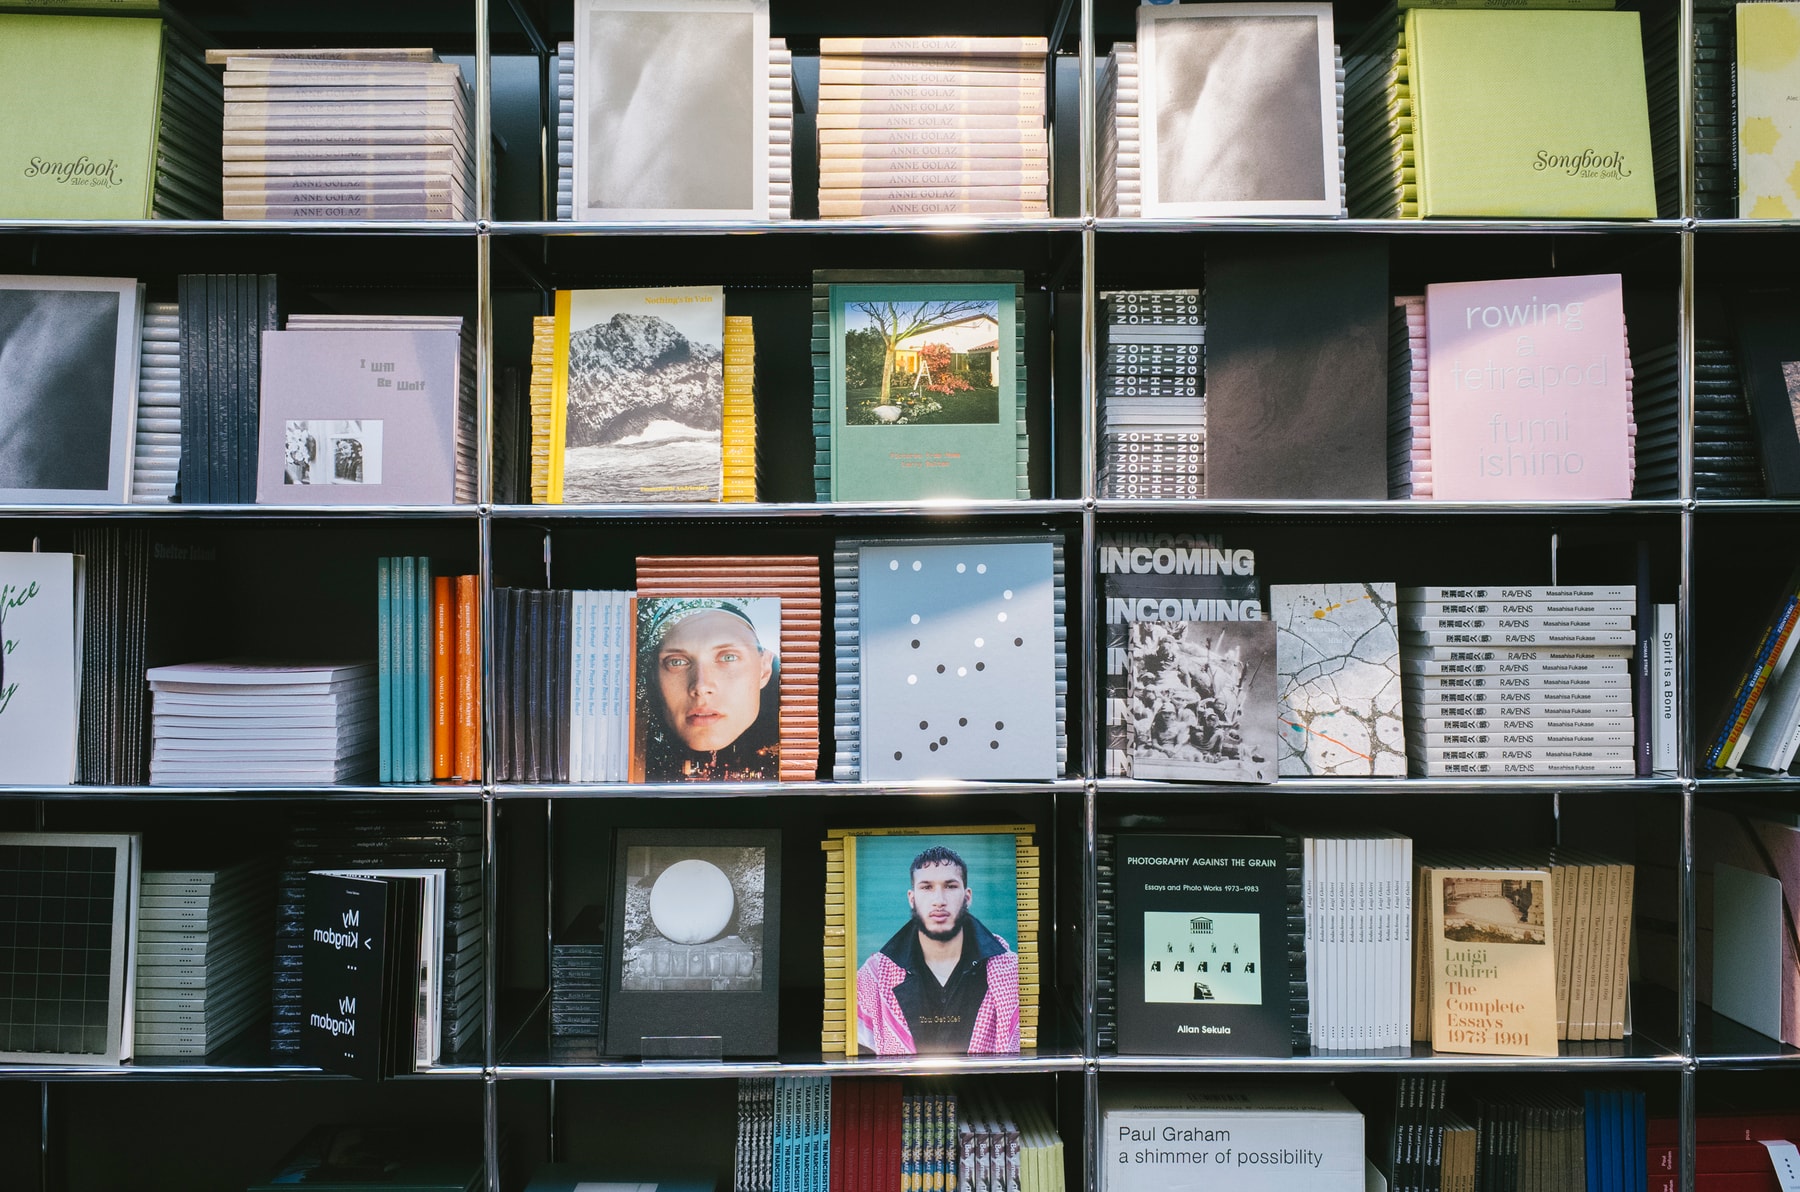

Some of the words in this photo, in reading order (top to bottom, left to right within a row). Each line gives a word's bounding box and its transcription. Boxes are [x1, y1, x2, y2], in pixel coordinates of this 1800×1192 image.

[890, 41, 919, 49] ANNE
[922, 41, 957, 49] GOLAZ
[1533, 149, 1631, 177] Songbook
[24, 156, 122, 186] Songbook
[1600, 170, 1621, 180] Soth
[90, 177, 112, 188] Soth
[1116, 295, 1196, 304] NOTHING
[1117, 304, 1197, 314] NOTHING
[1466, 296, 1584, 331] rowing
[1117, 315, 1198, 325] NOTHING
[1118, 345, 1198, 354] NOTHING
[1516, 336, 1534, 356] a
[1116, 355, 1198, 364] NOTHING
[1116, 365, 1198, 375] NOTHING
[1115, 376, 1196, 386] NOTHING
[1452, 356, 1608, 396] tetrapod
[377, 378, 391, 387] Be
[1115, 386, 1196, 396] NOTHING
[1489, 410, 1569, 443] fumi
[1118, 433, 1199, 442] NOTHING
[1118, 443, 1198, 453] NOTHING
[1480, 443, 1584, 478] ishino
[1117, 464, 1197, 474] NOTHING
[1117, 474, 1197, 484] NOTHING
[1116, 485, 1197, 494] NOTHING
[1101, 547, 1254, 576] INCOMING
[1107, 598, 1262, 624] INCOMING
[1663, 632, 1672, 665] Spirit
[1664, 666, 1672, 676] is
[1664, 691, 1673, 719] Bone
[1504, 721, 1533, 729] RAVENS
[1128, 857, 1189, 866] PHOTOGRAPHY
[1193, 858, 1228, 867] AGAINST
[1232, 858, 1246, 867] THE
[1248, 859, 1276, 868] GRAIN
[1145, 884, 1165, 892] Essays
[1446, 948, 1486, 966] Luigi
[1445, 964, 1497, 978] Ghirri
[1445, 982, 1477, 995] The
[1446, 999, 1525, 1016] Complete
[1448, 1014, 1503, 1031] Essays
[1202, 1026, 1231, 1034] Sekula
[1119, 1127, 1155, 1141] Paul
[1162, 1127, 1230, 1142] Graham
[1119, 1152, 1128, 1164] a
[1135, 1149, 1208, 1164] shimmer
[1215, 1149, 1231, 1164] of
[1238, 1149, 1323, 1167] possibility
